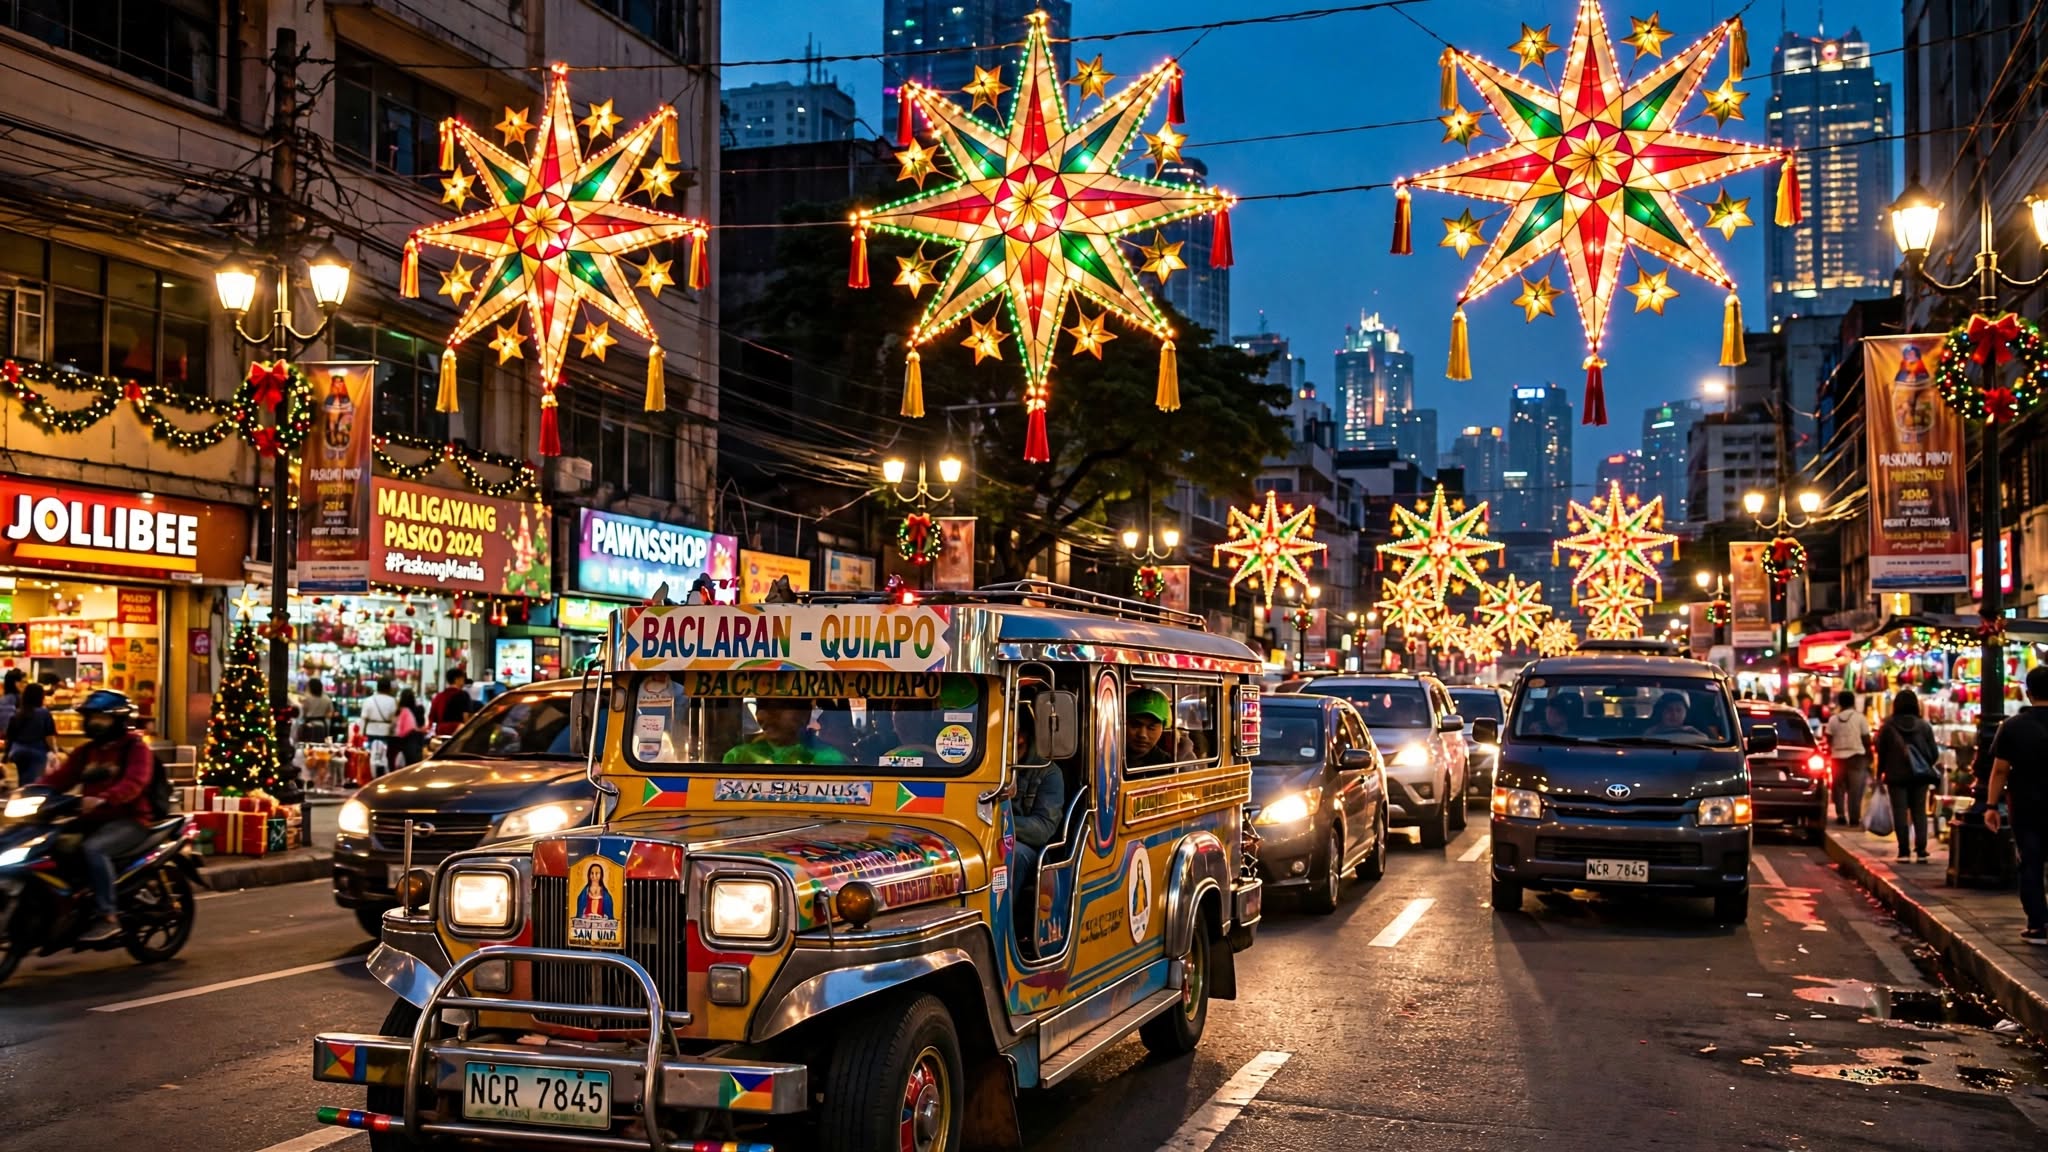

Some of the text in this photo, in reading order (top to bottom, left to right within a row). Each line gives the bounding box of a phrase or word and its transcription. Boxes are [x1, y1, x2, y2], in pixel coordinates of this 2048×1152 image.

[7, 494, 198, 556] JOLLIBEE
[378, 487, 497, 532] MALIGAYANG
[384, 520, 484, 558] PASKO 2024
[591, 518, 707, 568] PAWNSSHOP
[385, 552, 485, 582] #PaskongManila
[642, 615, 791, 658] BACLARAN
[820, 614, 935, 661] QUIAPO
[1588, 863, 1609, 876] NCR
[471, 1073, 603, 1114] NCR 7845
